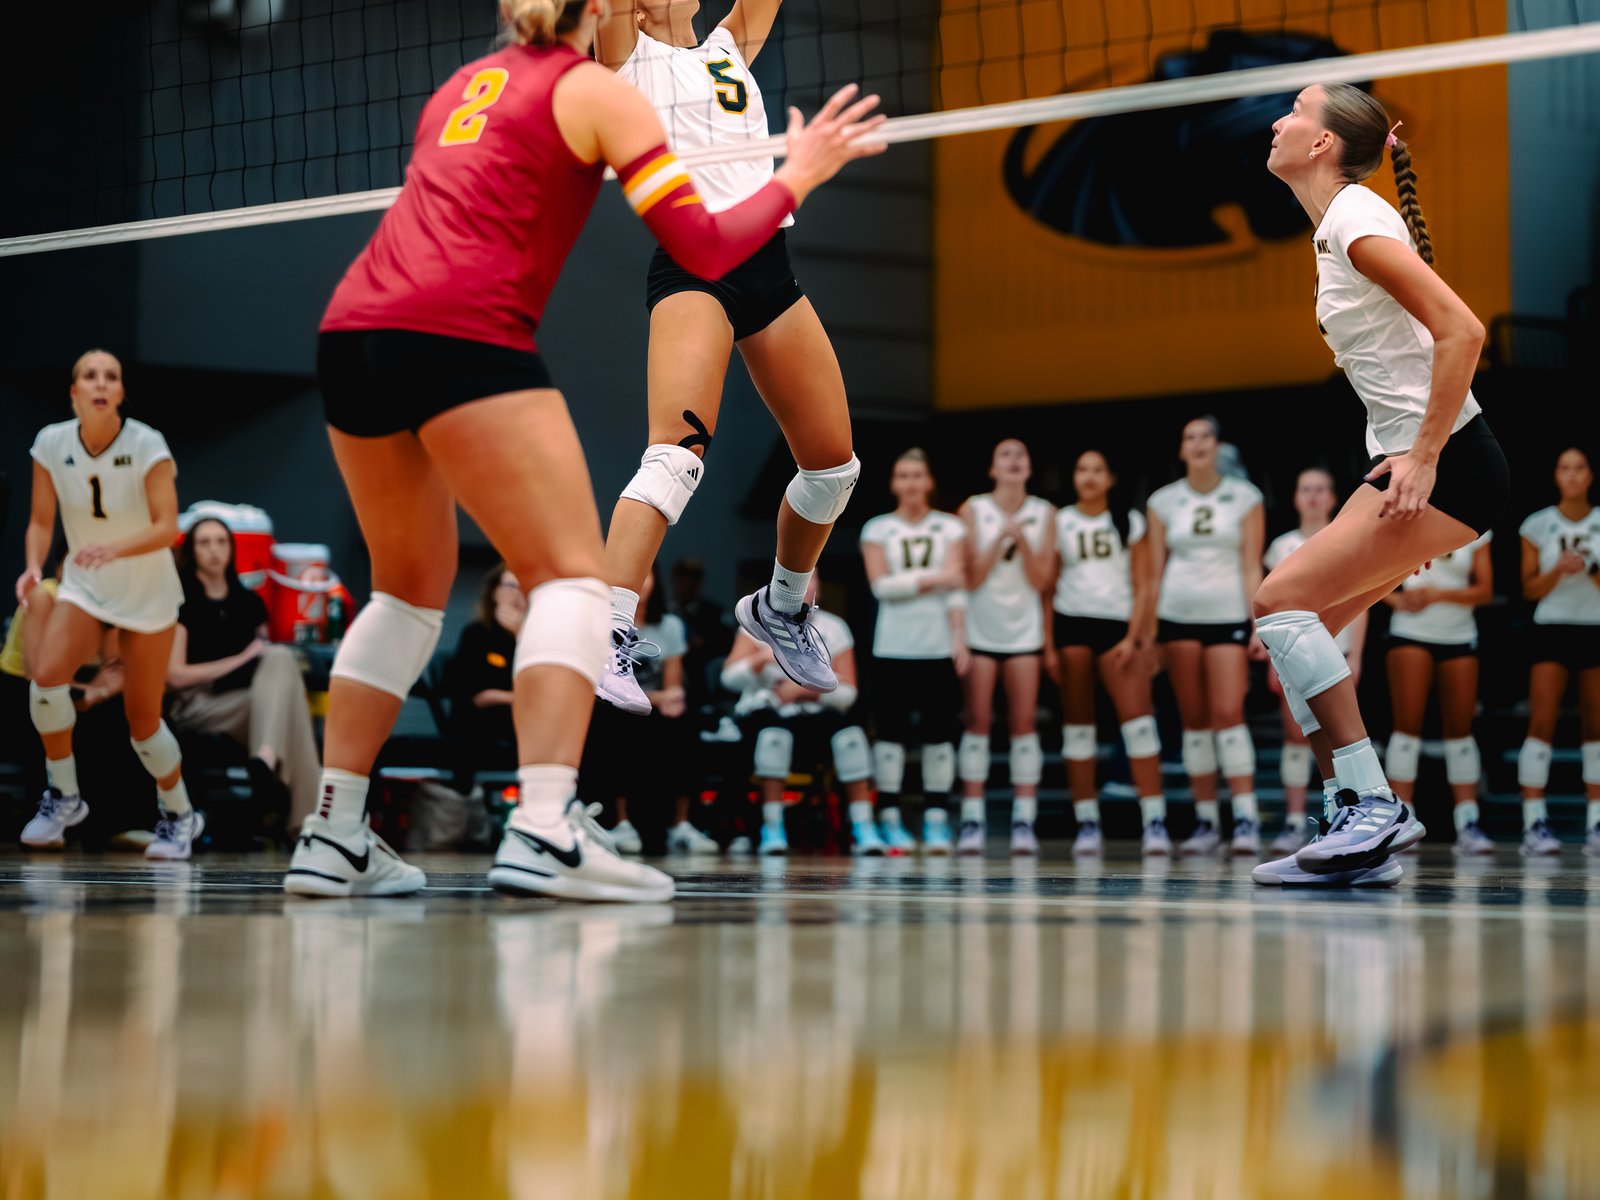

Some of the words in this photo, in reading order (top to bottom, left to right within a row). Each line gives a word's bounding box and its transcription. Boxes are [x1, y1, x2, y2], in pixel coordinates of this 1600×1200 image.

[706, 57, 748, 115] 5
[437, 67, 509, 147] 2
[89, 474, 107, 519] 1
[1192, 506, 1214, 536] 2
[899, 537, 934, 569] 17
[1078, 529, 1112, 560] 16
